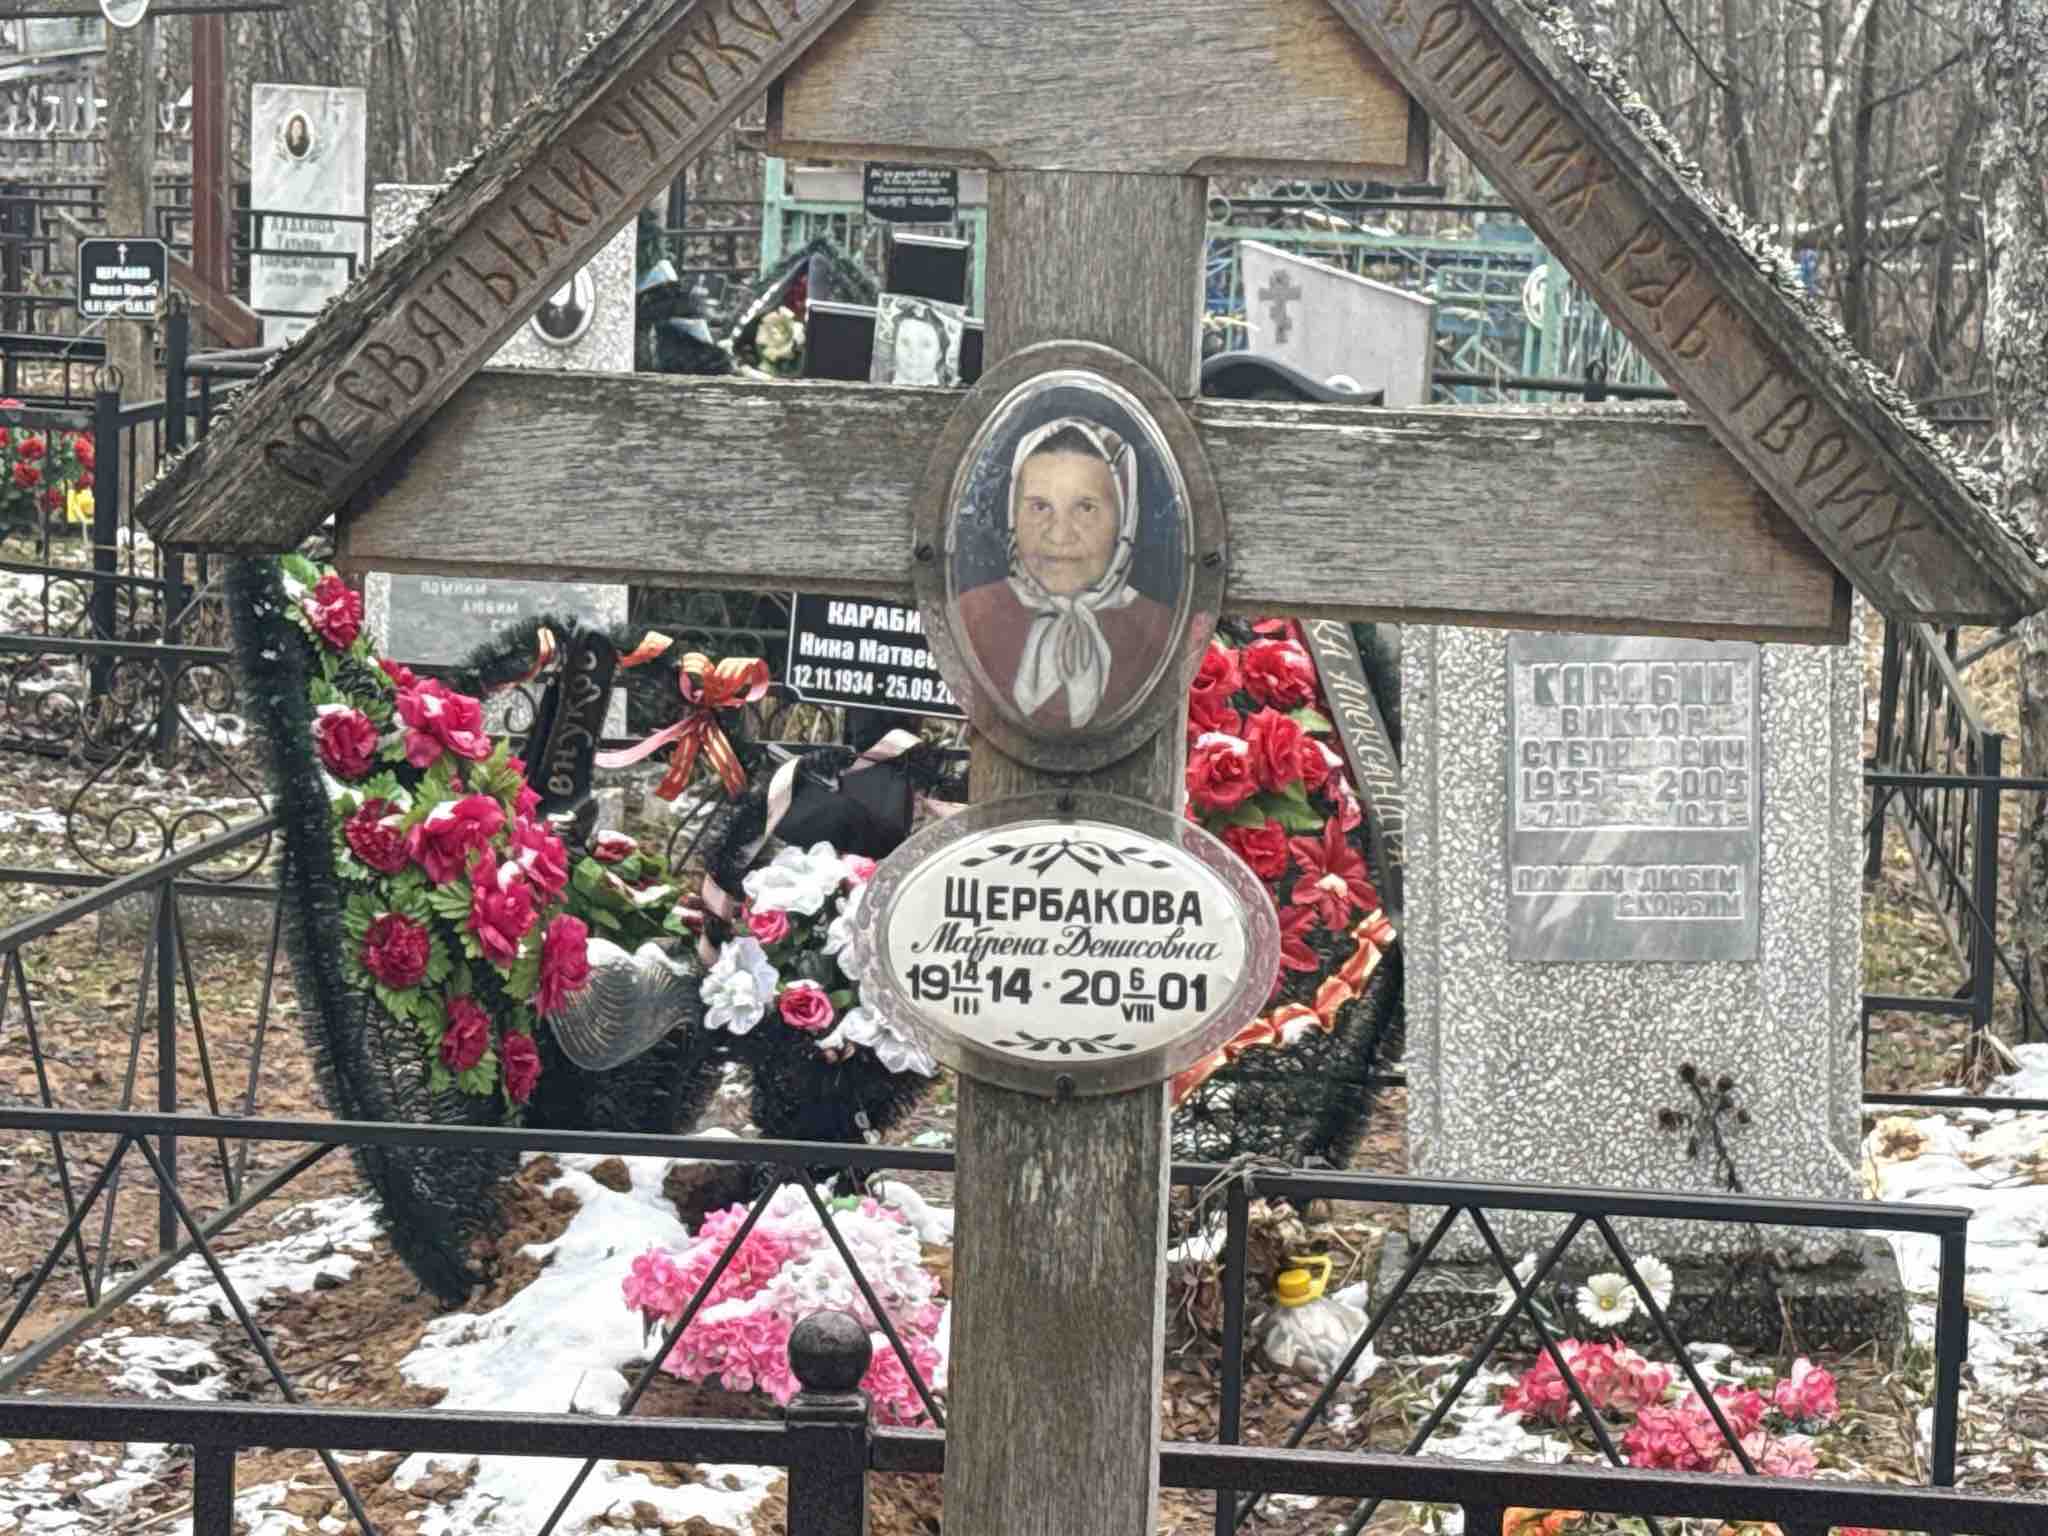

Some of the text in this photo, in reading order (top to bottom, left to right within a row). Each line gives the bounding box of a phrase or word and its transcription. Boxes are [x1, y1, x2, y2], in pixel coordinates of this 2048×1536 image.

[333, 147, 624, 422] СВЯТЫМИ
[600, 0, 801, 162] УПОКО
[1730, 360, 1925, 570] ТВОИХ
[827, 600, 927, 635] КАРАБИ
[799, 631, 855, 662] Нина
[793, 663, 875, 696] 12.11.1934
[1561, 705, 1708, 738] ВИКТОР
[1521, 768, 1602, 801] 1935
[944, 876, 1203, 927] ЩЕРБАКОВА
[1053, 924, 1222, 960] Денисовна
